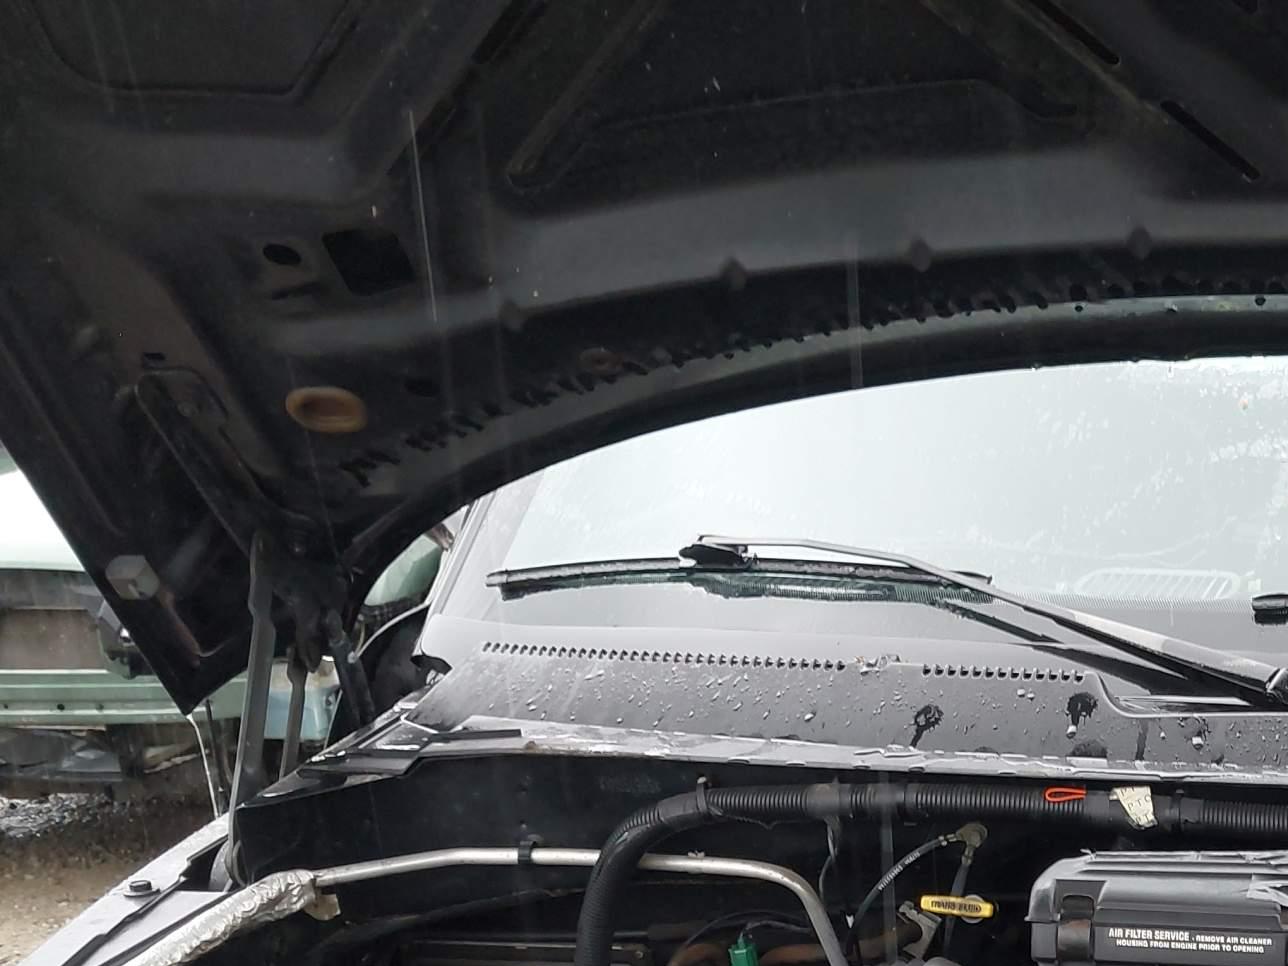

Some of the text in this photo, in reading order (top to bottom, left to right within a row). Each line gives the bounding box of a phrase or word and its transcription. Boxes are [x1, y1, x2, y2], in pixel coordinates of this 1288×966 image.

[1108, 927, 1273, 946] AIR FILTER SERVICE REMOVE AIR CLEANER
[1116, 938, 1265, 954] HOUSING FROM ENGINE PRIOR TO OPENING
